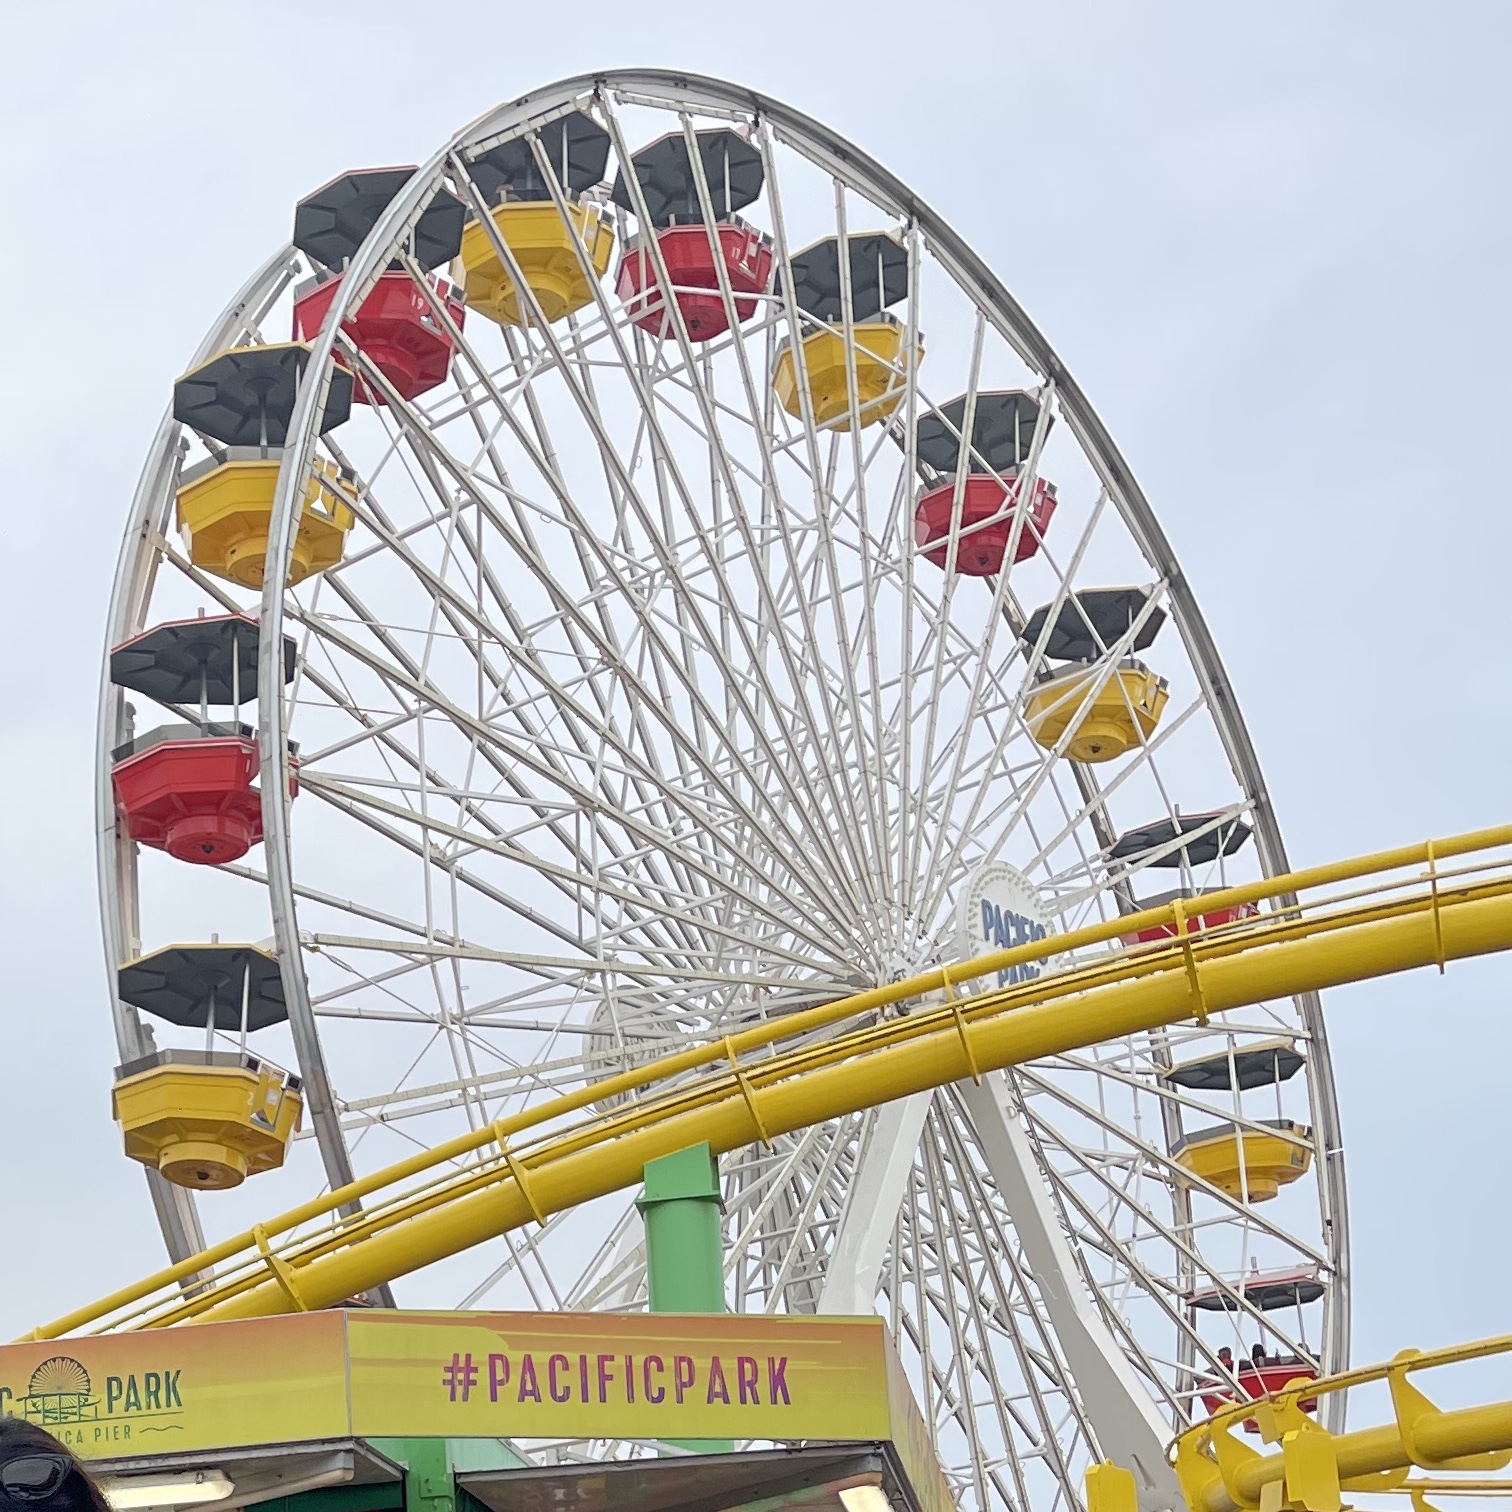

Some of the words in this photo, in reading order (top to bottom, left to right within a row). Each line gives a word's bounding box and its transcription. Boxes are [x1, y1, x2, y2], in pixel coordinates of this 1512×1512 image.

[106, 1369, 183, 1414] PARK
[441, 1352, 792, 1406] #PACIFICPARK
[94, 1424, 131, 1442] PIER
